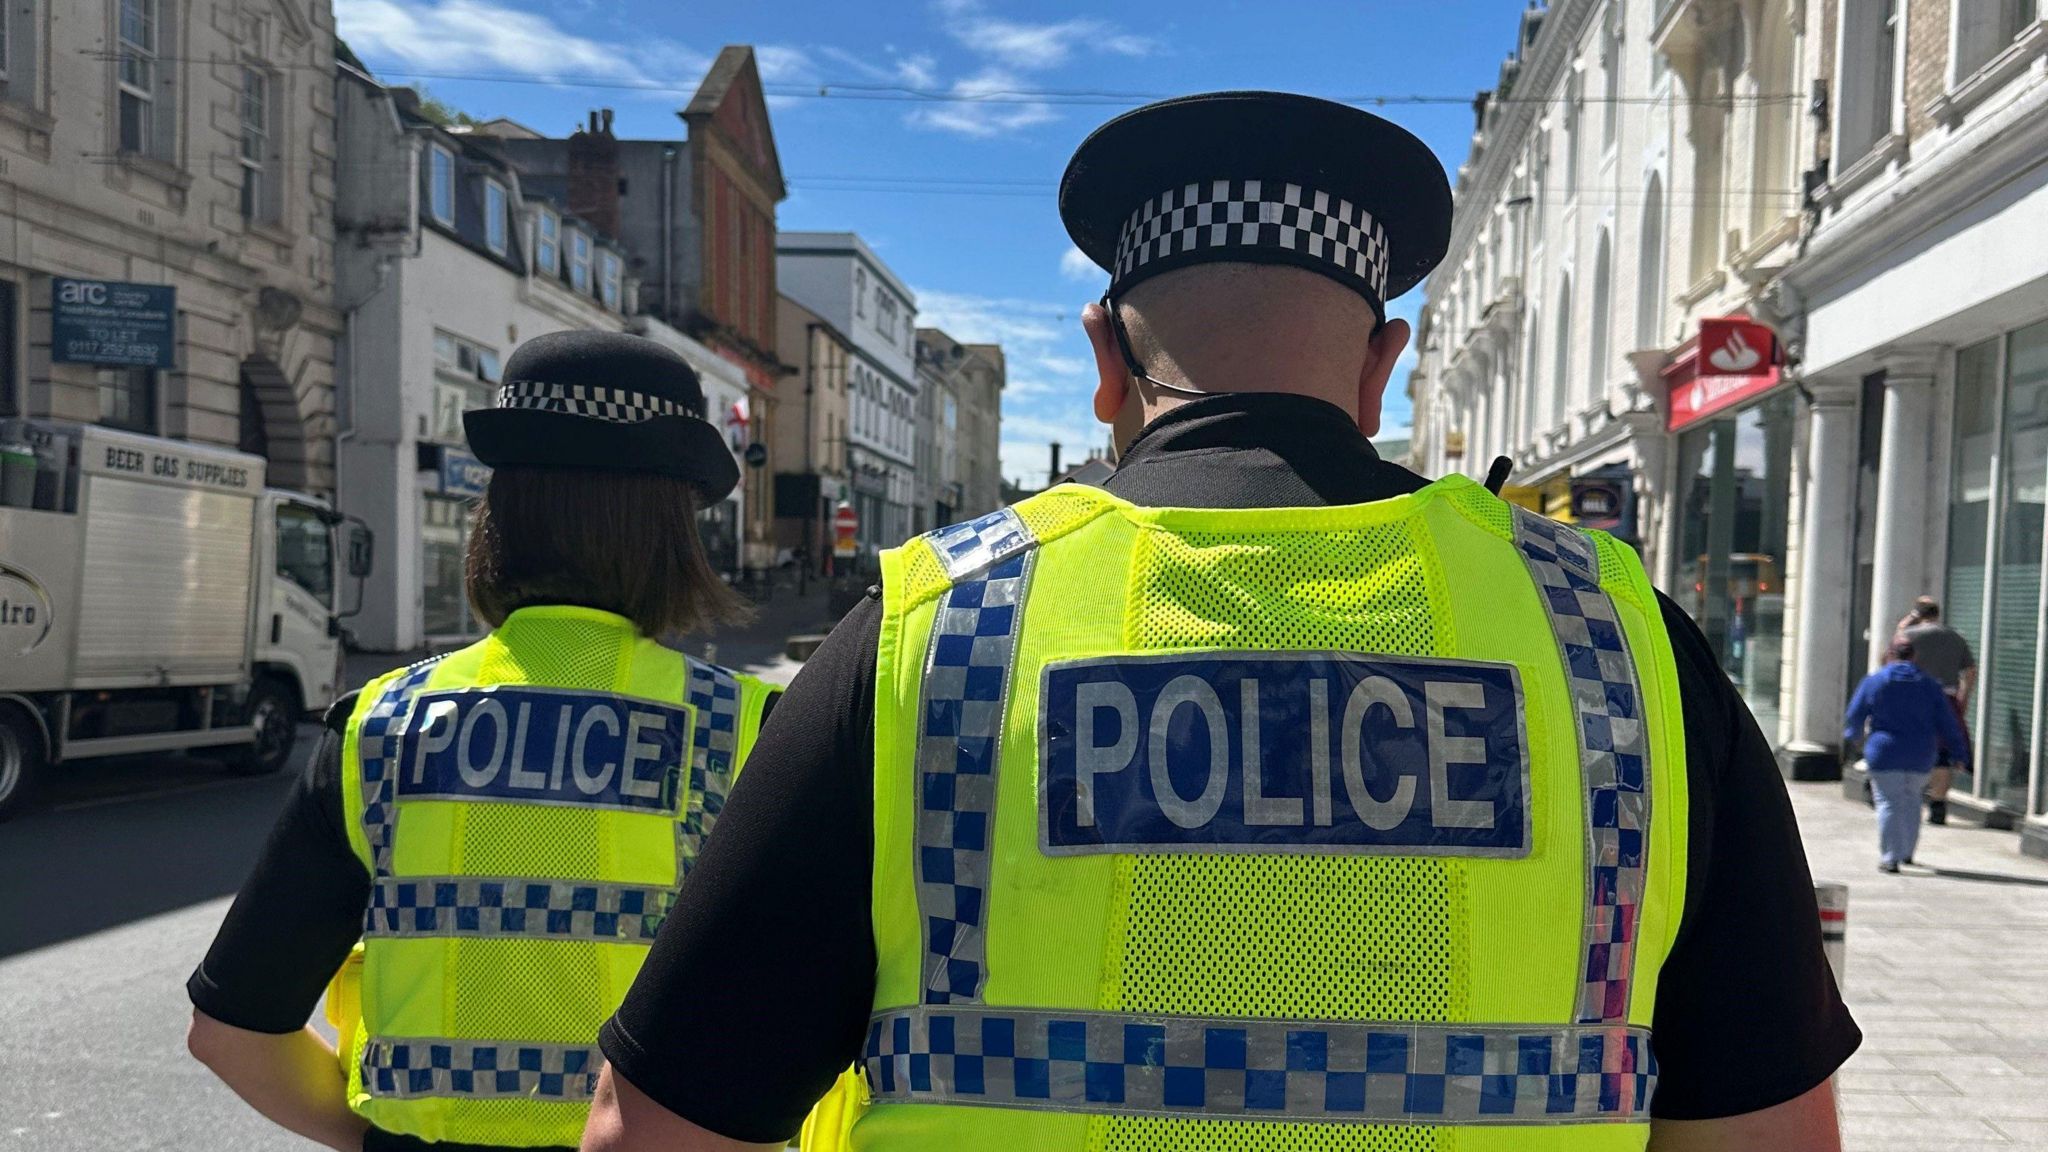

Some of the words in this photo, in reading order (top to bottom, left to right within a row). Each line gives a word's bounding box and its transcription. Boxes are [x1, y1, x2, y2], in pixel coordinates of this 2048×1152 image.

[60, 280, 107, 305] arc
[87, 328, 110, 341] TO
[112, 329, 139, 342] LET
[106, 447, 144, 472] BEER
[153, 455, 179, 478] GAS
[186, 460, 248, 487] SUPPLIES
[412, 697, 667, 799] POLICE
[1075, 674, 1495, 831] POLICE
